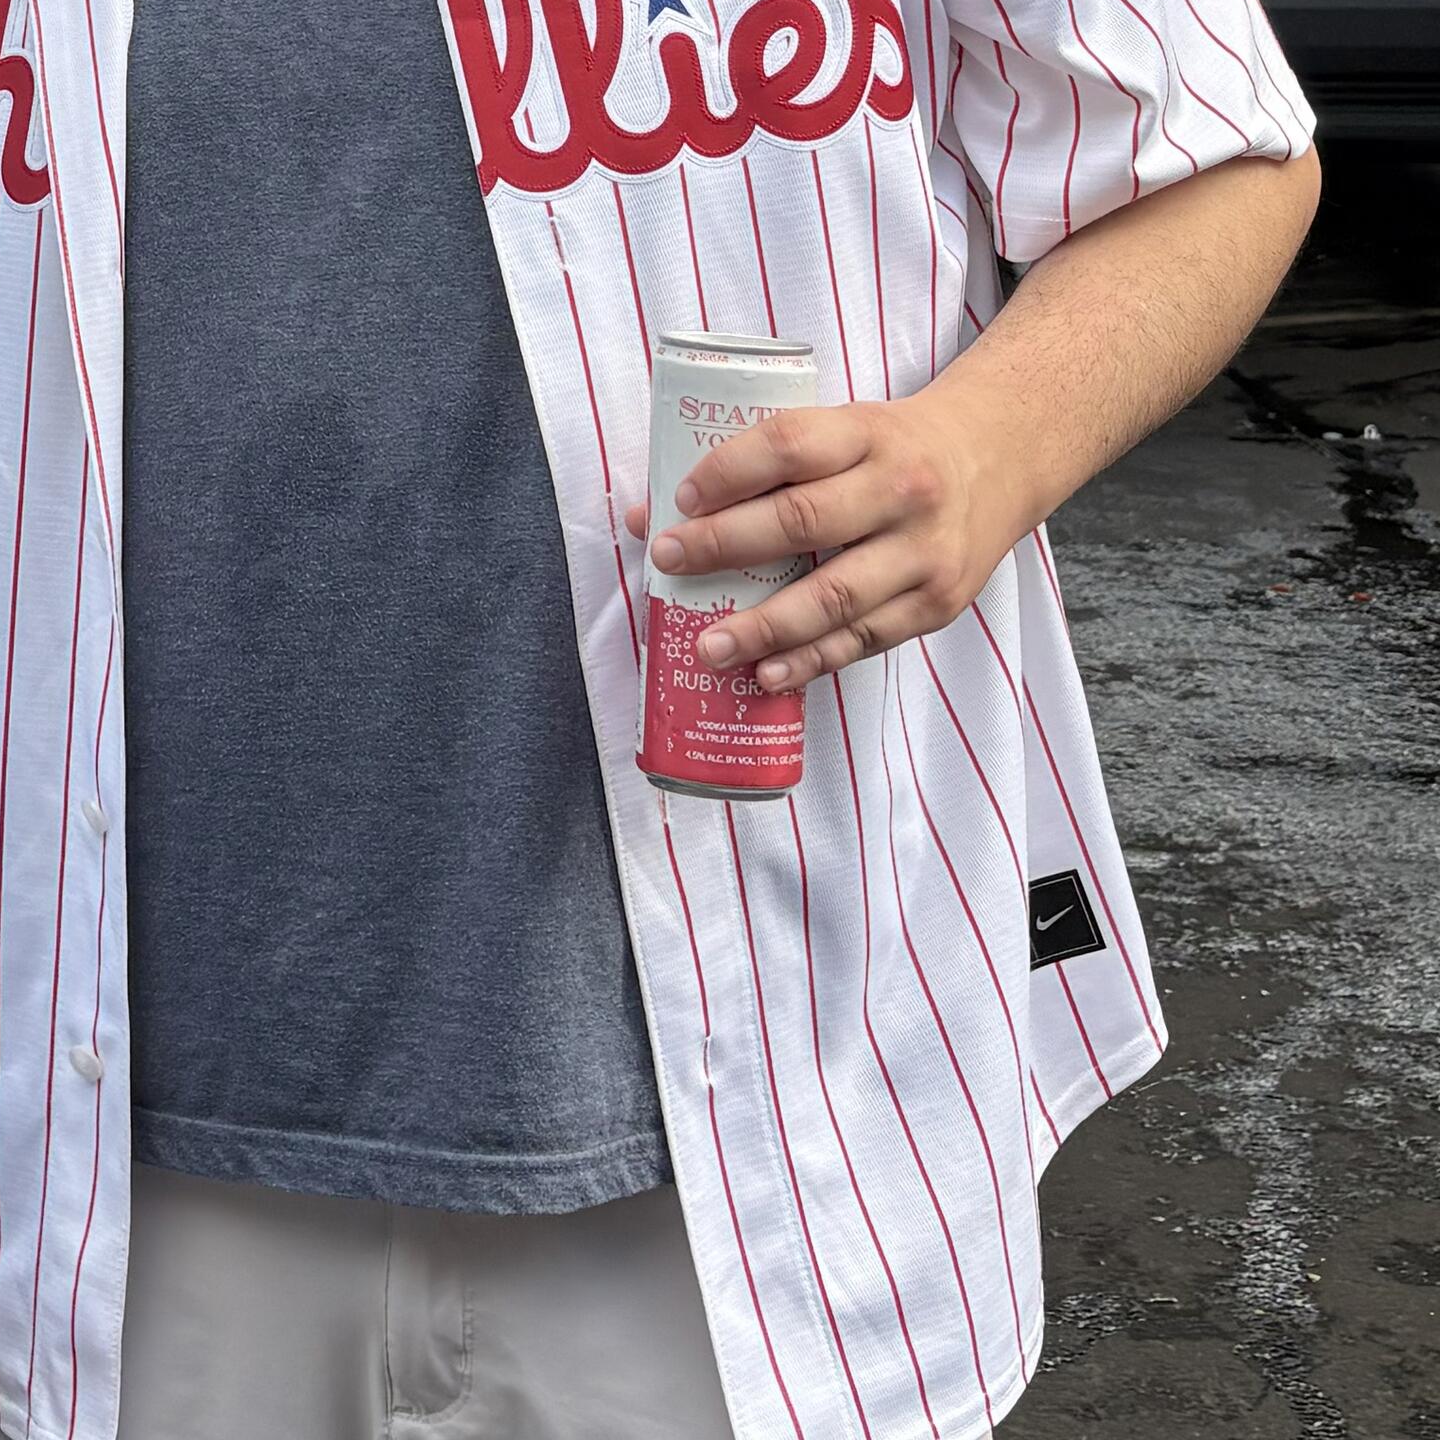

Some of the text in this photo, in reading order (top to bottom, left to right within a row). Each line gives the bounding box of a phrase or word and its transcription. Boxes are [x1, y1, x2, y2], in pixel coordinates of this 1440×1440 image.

[679, 395, 789, 426] STAT
[673, 669, 726, 693] RUBY
[696, 720, 727, 732] VODKA
